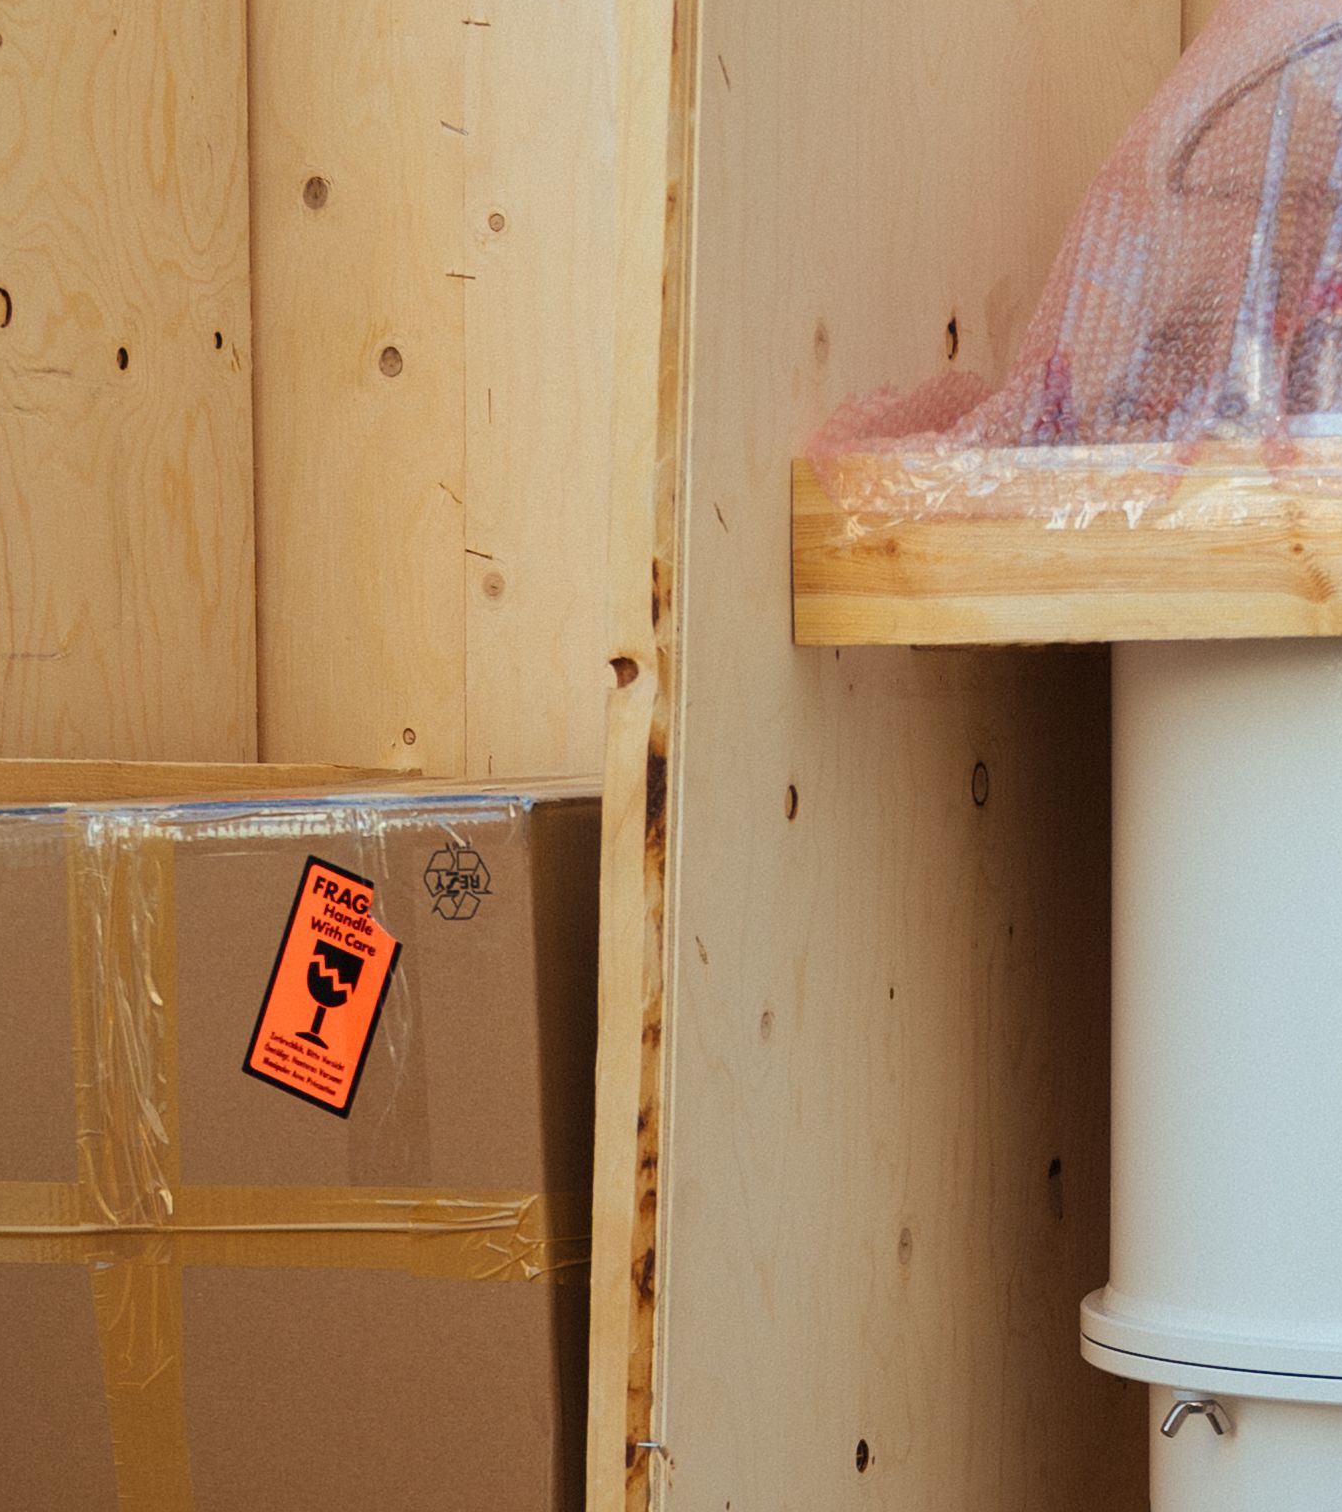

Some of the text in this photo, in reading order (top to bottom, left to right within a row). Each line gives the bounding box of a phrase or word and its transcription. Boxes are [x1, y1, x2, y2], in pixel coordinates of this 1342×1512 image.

[312, 875, 371, 918] FRAG
[310, 915, 377, 957] With Care
[323, 903, 374, 936] Handle
